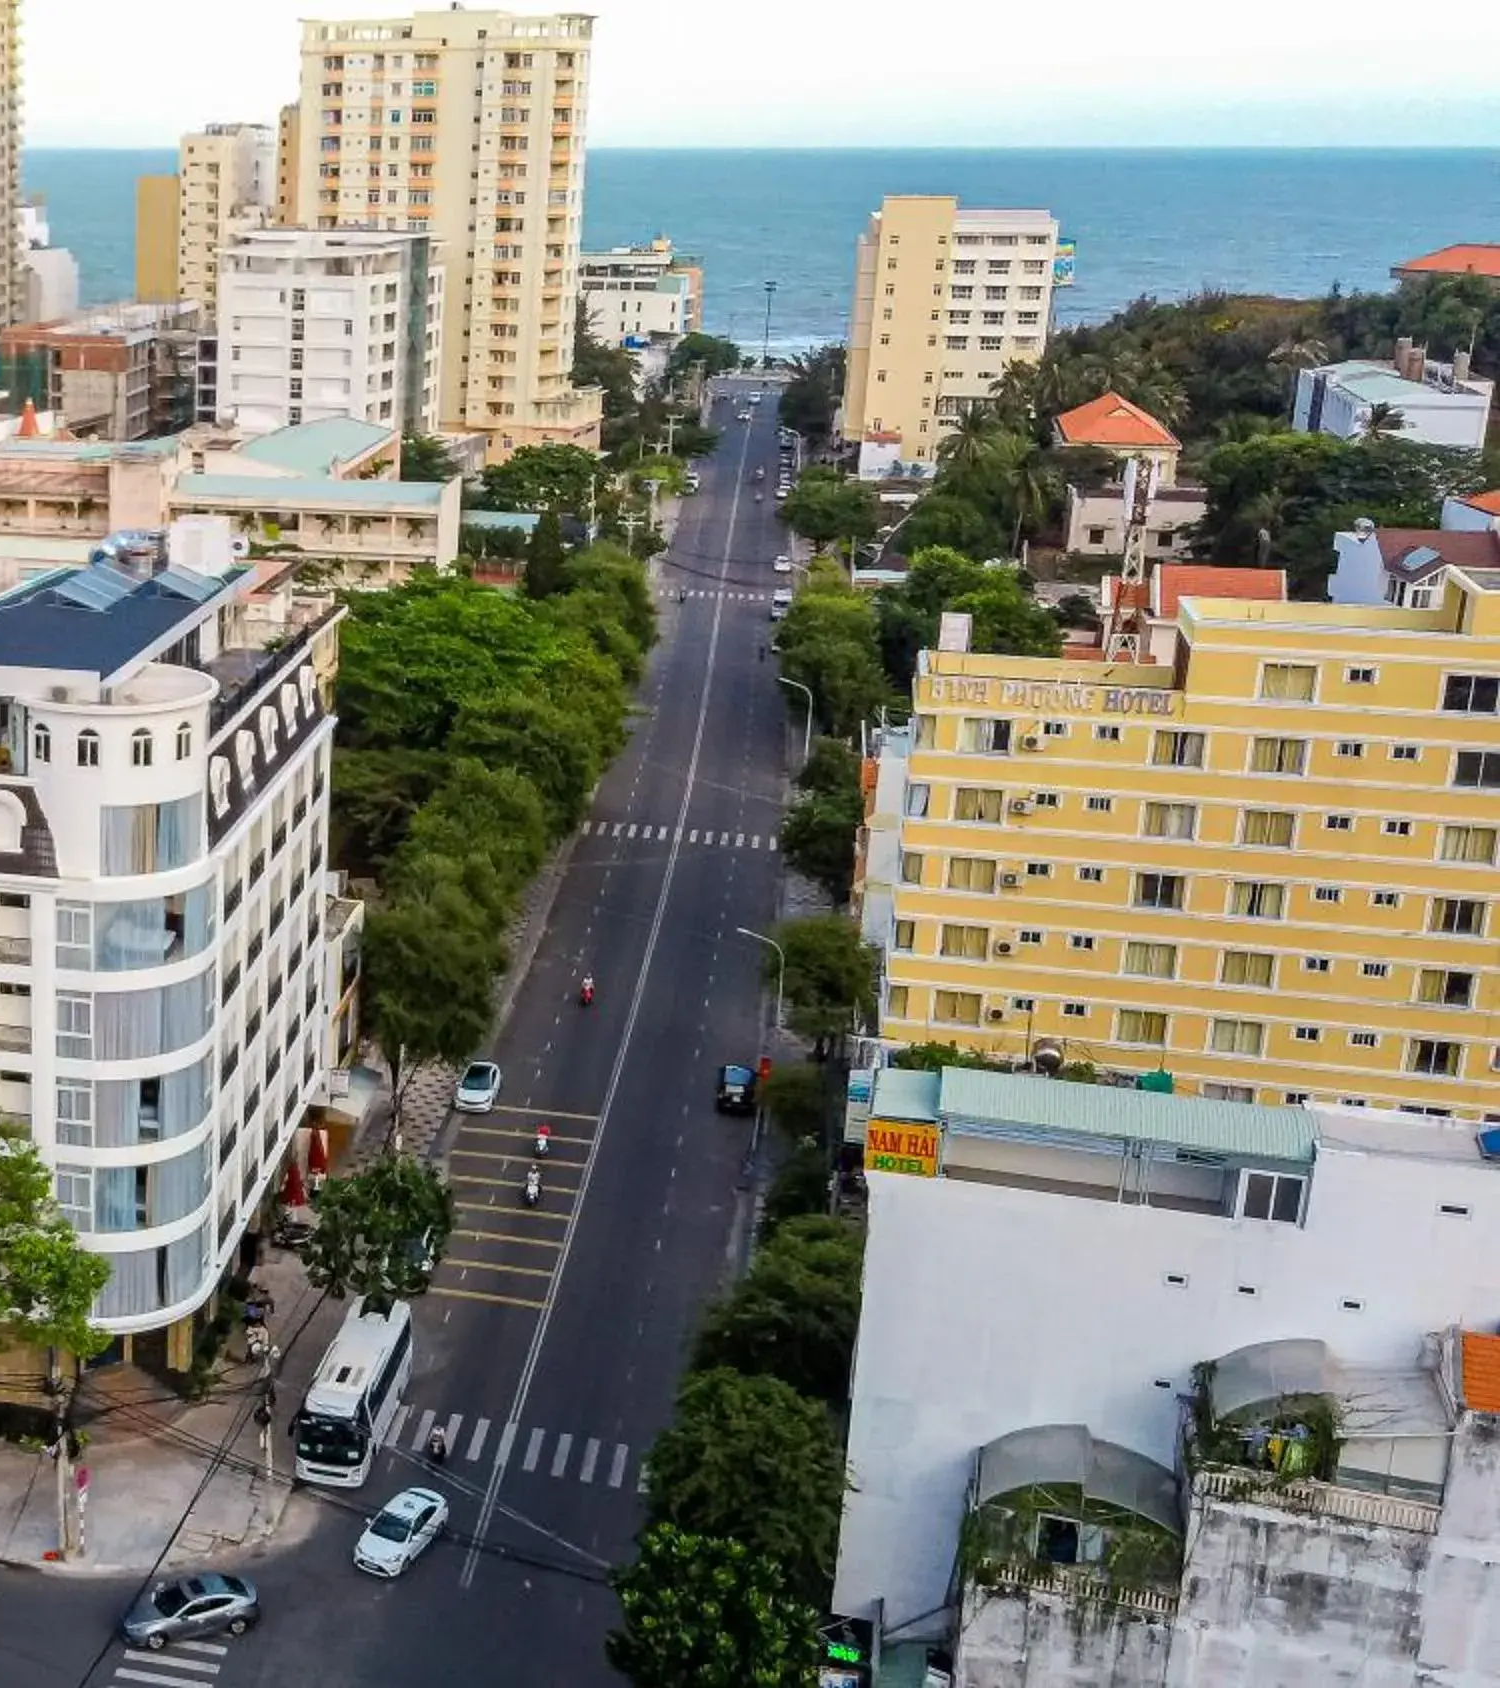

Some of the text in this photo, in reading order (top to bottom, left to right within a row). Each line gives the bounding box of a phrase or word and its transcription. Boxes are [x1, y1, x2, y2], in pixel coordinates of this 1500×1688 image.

[1103, 688, 1175, 716] HOTEL
[867, 1129, 902, 1153] NAM
[874, 1155, 924, 1174] HOTEL
